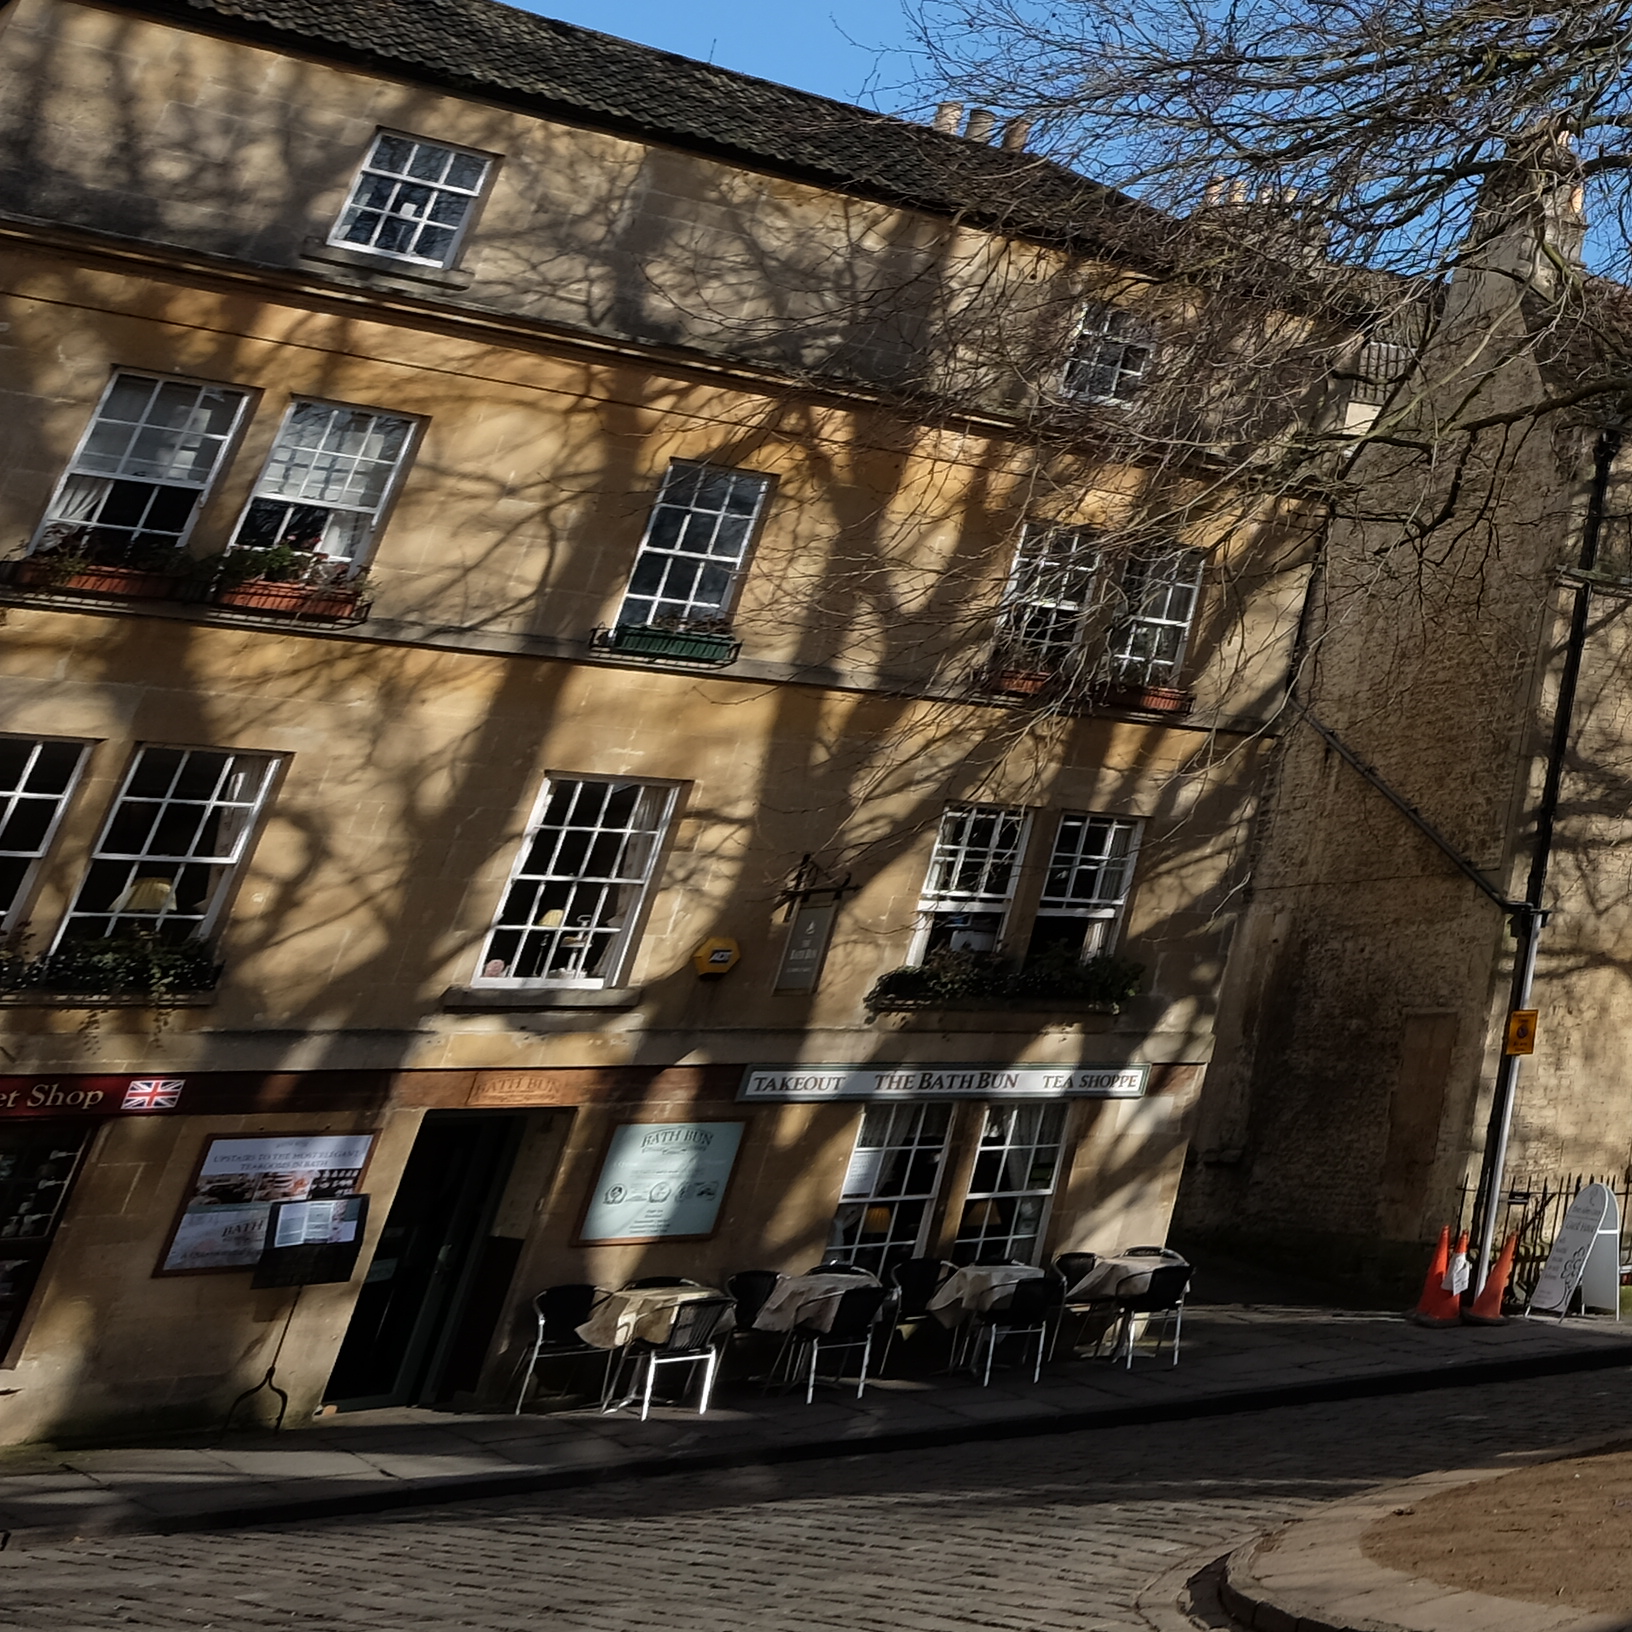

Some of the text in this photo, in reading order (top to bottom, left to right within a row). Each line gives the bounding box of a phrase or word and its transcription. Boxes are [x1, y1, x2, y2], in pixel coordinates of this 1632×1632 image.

[526, 1076, 560, 1094] BUN
[753, 1072, 1139, 1091] TAKEOUT THE BATH BUN TEA SHOPPE
[27, 1083, 105, 1110] Shop
[641, 1128, 714, 1148] BATH BUN
[222, 1220, 264, 1237] BATH
